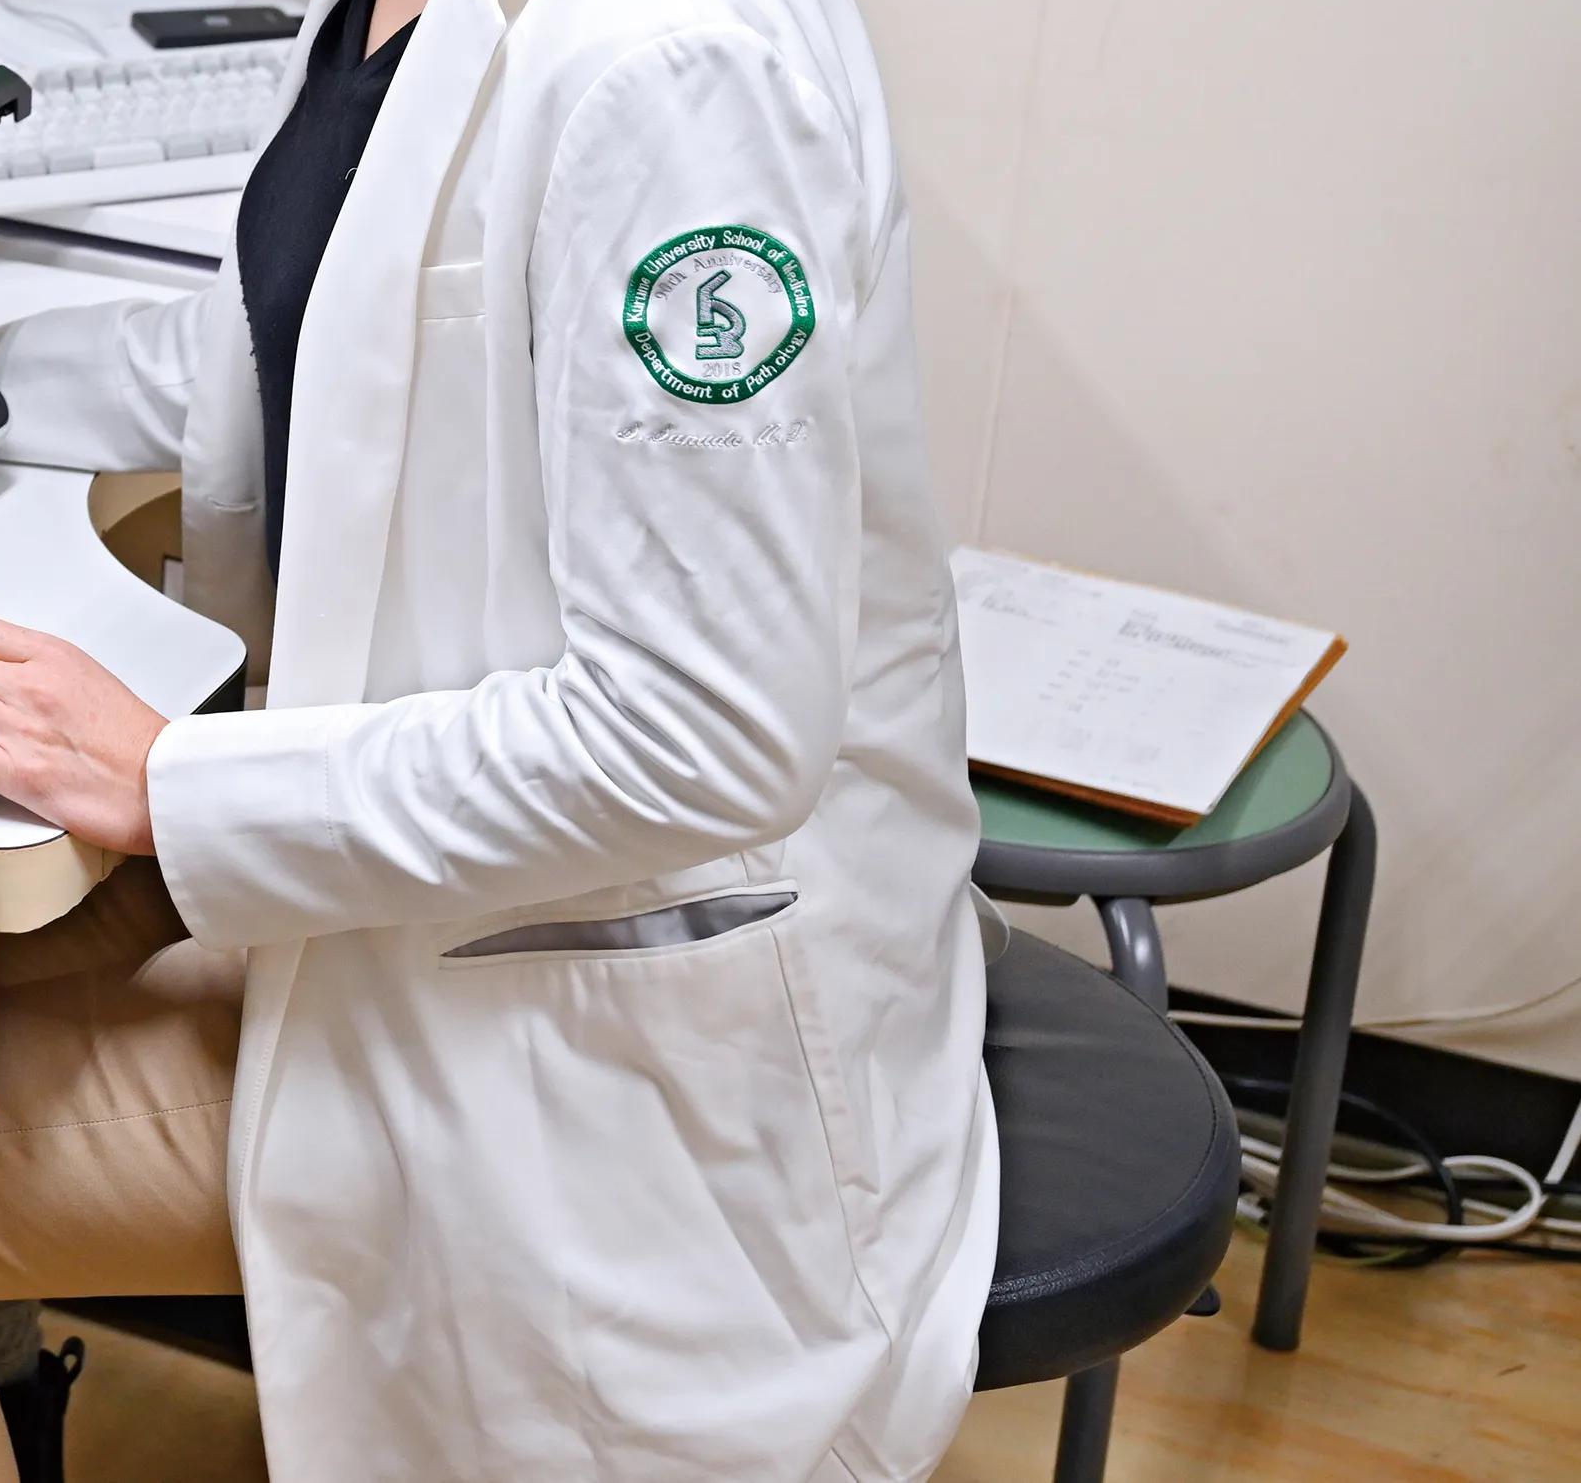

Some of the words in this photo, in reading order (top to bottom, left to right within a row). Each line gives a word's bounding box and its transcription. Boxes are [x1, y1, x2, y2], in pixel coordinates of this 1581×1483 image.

[626, 277, 651, 322] Kurume
[645, 234, 715, 275] University
[723, 230, 766, 252] School
[767, 249, 788, 262] of
[781, 259, 809, 317] Medicine
[693, 253, 783, 295] Anniversary
[634, 333, 713, 398] Department
[721, 385, 740, 398] of
[745, 329, 807, 393] Pathology
[701, 362, 741, 378] 2018
